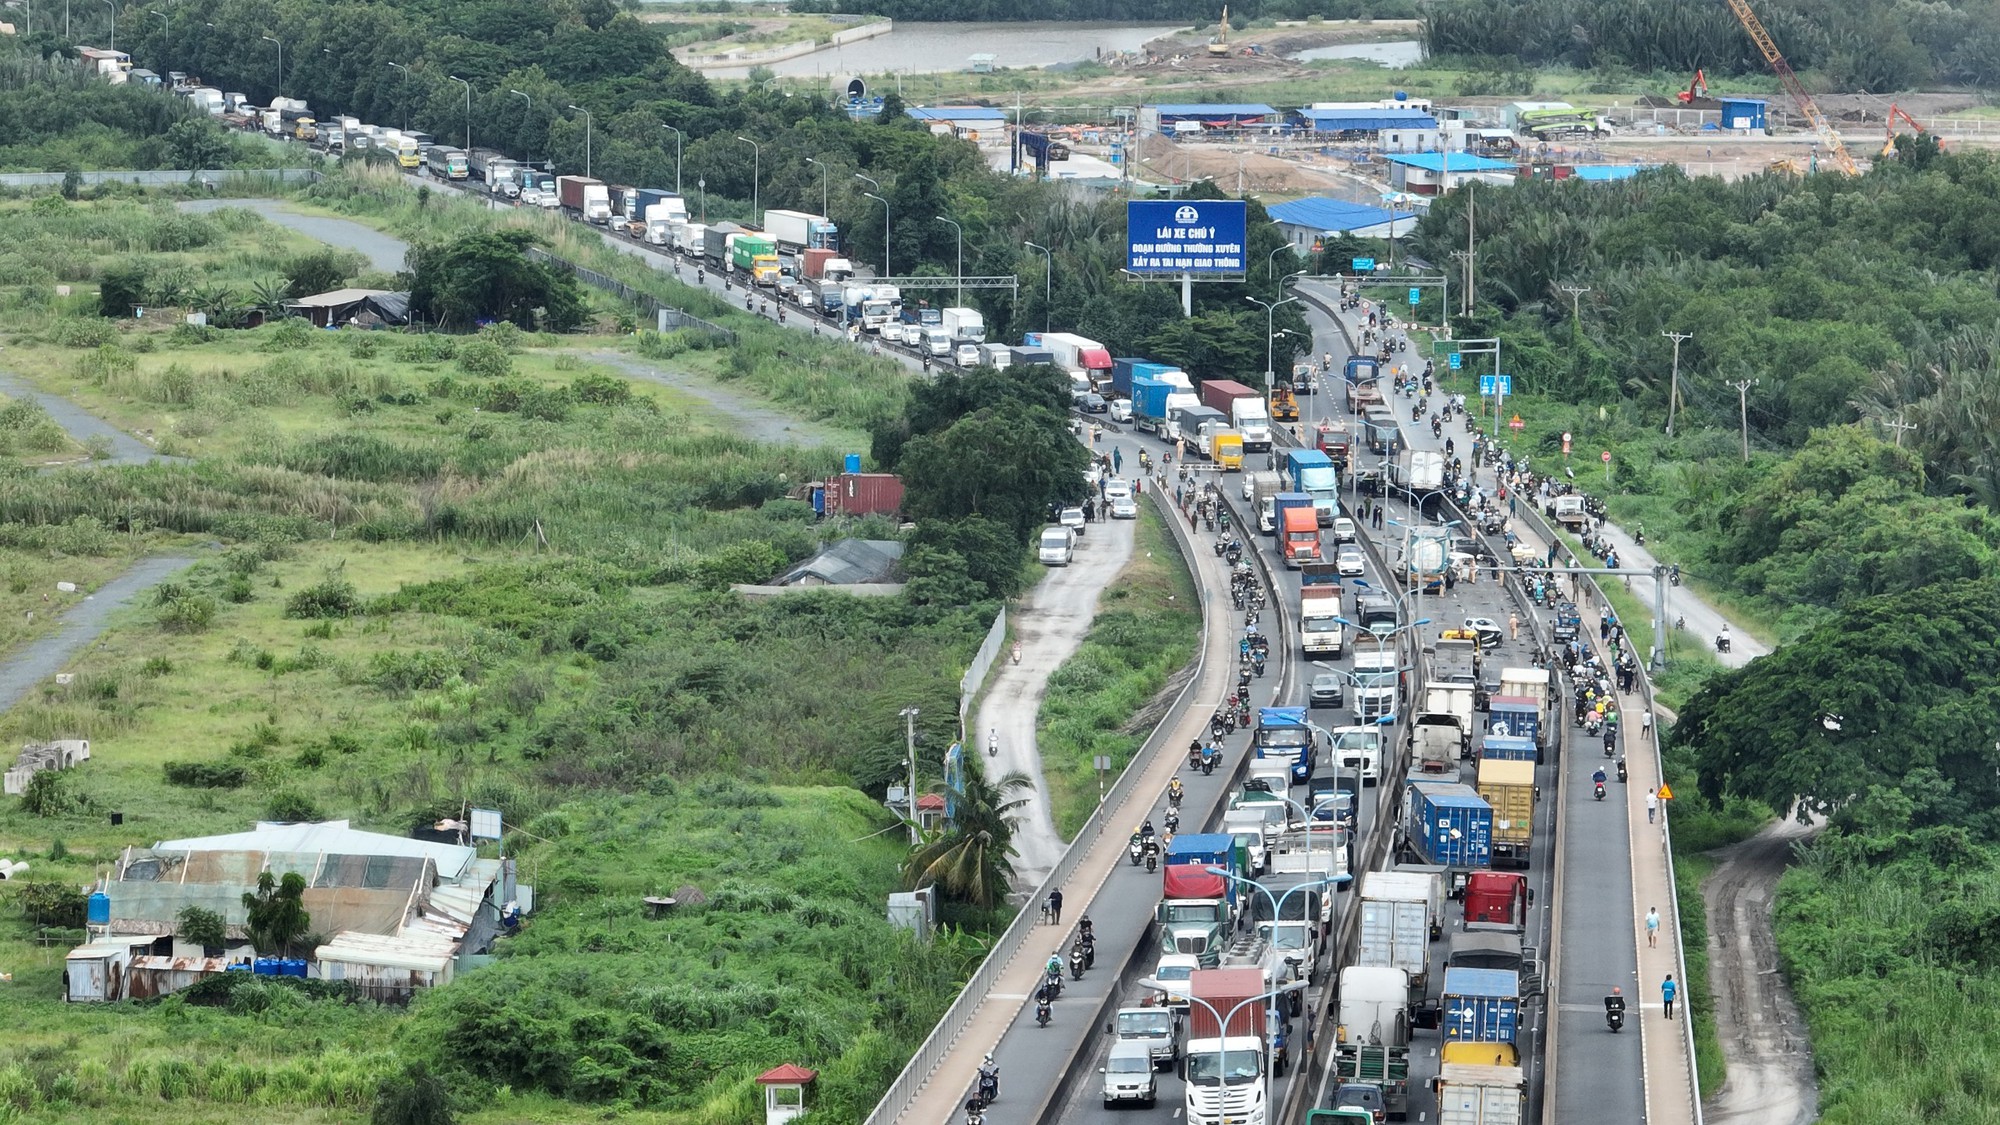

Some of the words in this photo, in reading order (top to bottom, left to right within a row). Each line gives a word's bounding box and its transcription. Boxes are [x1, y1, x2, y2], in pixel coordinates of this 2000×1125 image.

[1157, 226, 1171, 238] LÁI
[1174, 228, 1186, 238] XE
[1188, 226, 1207, 239] CHÚ
[1209, 226, 1215, 239] Ý
[1132, 243, 1154, 254] ĐOẠN
[1183, 242, 1213, 253] THƯỜNG
[1215, 242, 1240, 253] XUYÊN
[1150, 258, 1160, 266] RA
[1162, 258, 1174, 266] TAI
[1175, 258, 1192, 268] NẠN
[1194, 258, 1213, 267] GIAO
[1214, 256, 1240, 267] THÔNG
